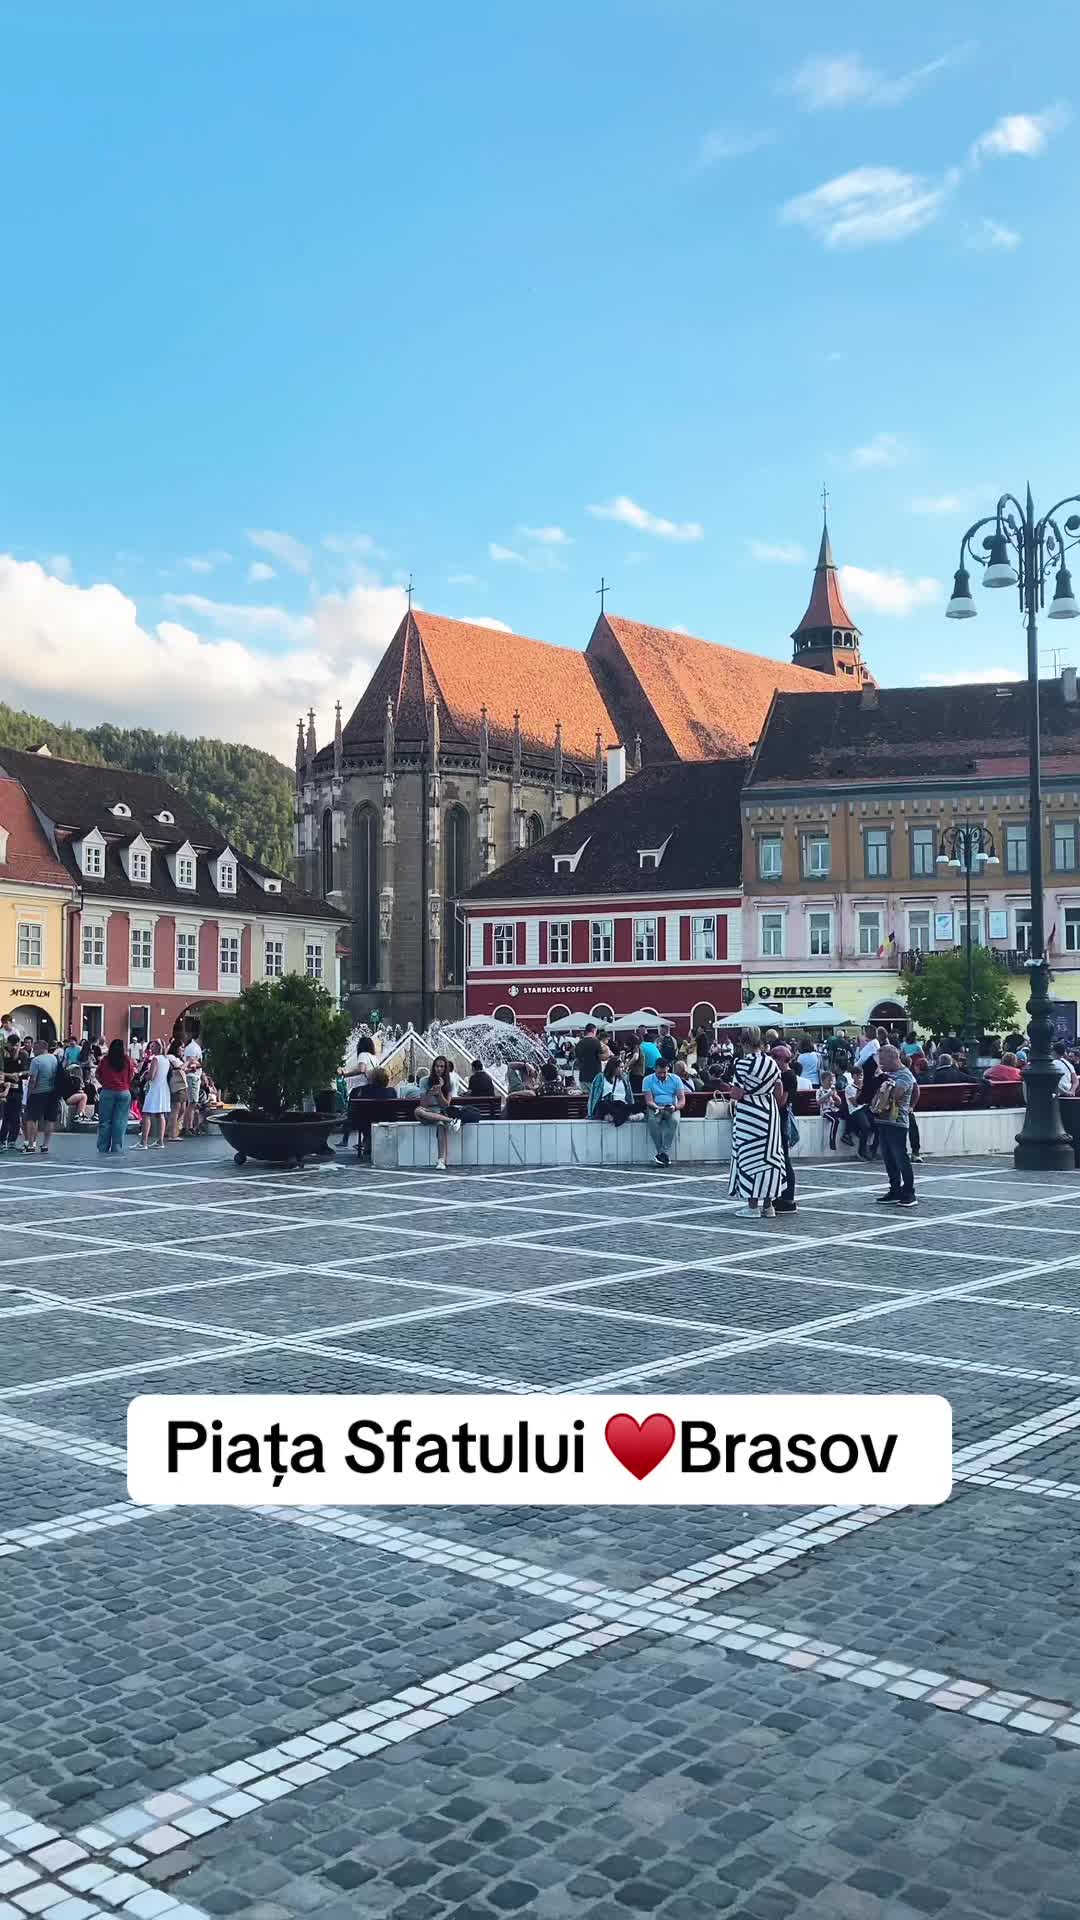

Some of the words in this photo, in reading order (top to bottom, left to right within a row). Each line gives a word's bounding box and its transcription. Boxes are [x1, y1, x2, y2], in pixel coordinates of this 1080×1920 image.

[10, 988, 51, 998] MUSEUM
[523, 986, 566, 994] STARBUCKS
[774, 987, 797, 995] FIVE
[798, 987, 814, 995] TO
